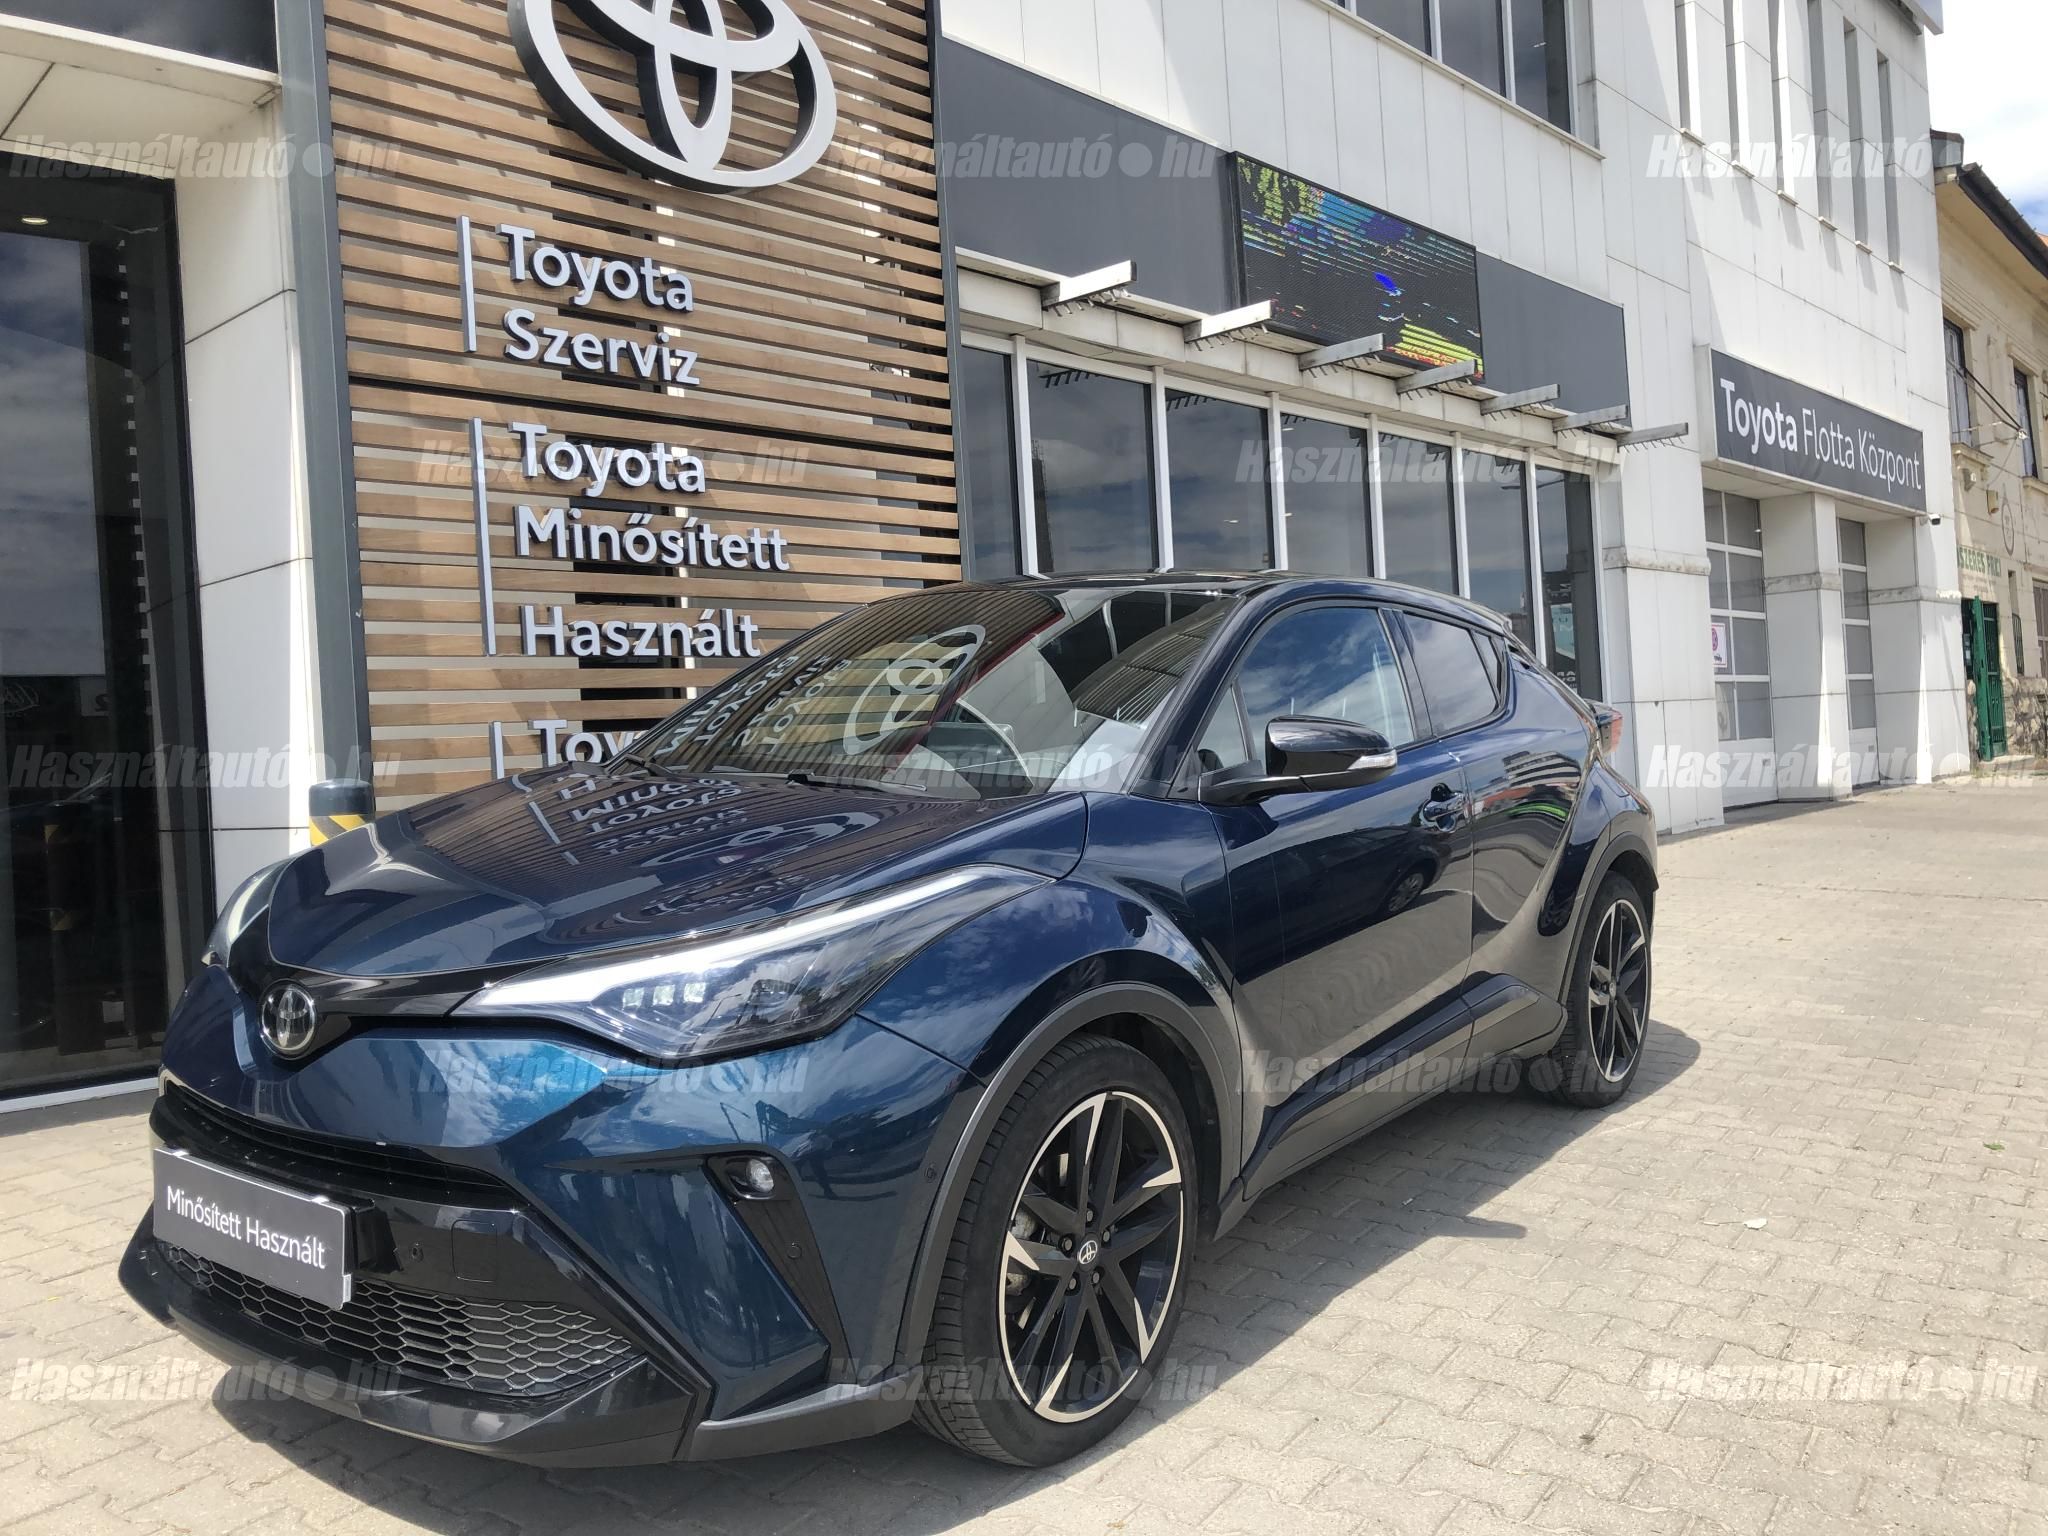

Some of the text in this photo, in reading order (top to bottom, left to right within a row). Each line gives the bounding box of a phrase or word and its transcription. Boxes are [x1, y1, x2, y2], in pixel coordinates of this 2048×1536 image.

[497, 224, 694, 312] Toyota
[503, 308, 700, 385] Szerviz
[509, 422, 706, 497] Toyota
[1720, 378, 1921, 492] Toyota Flotta Központ
[514, 507, 790, 571] Minősített
[520, 605, 761, 658] Használt
[167, 1185, 326, 1269] Minősített Használt
